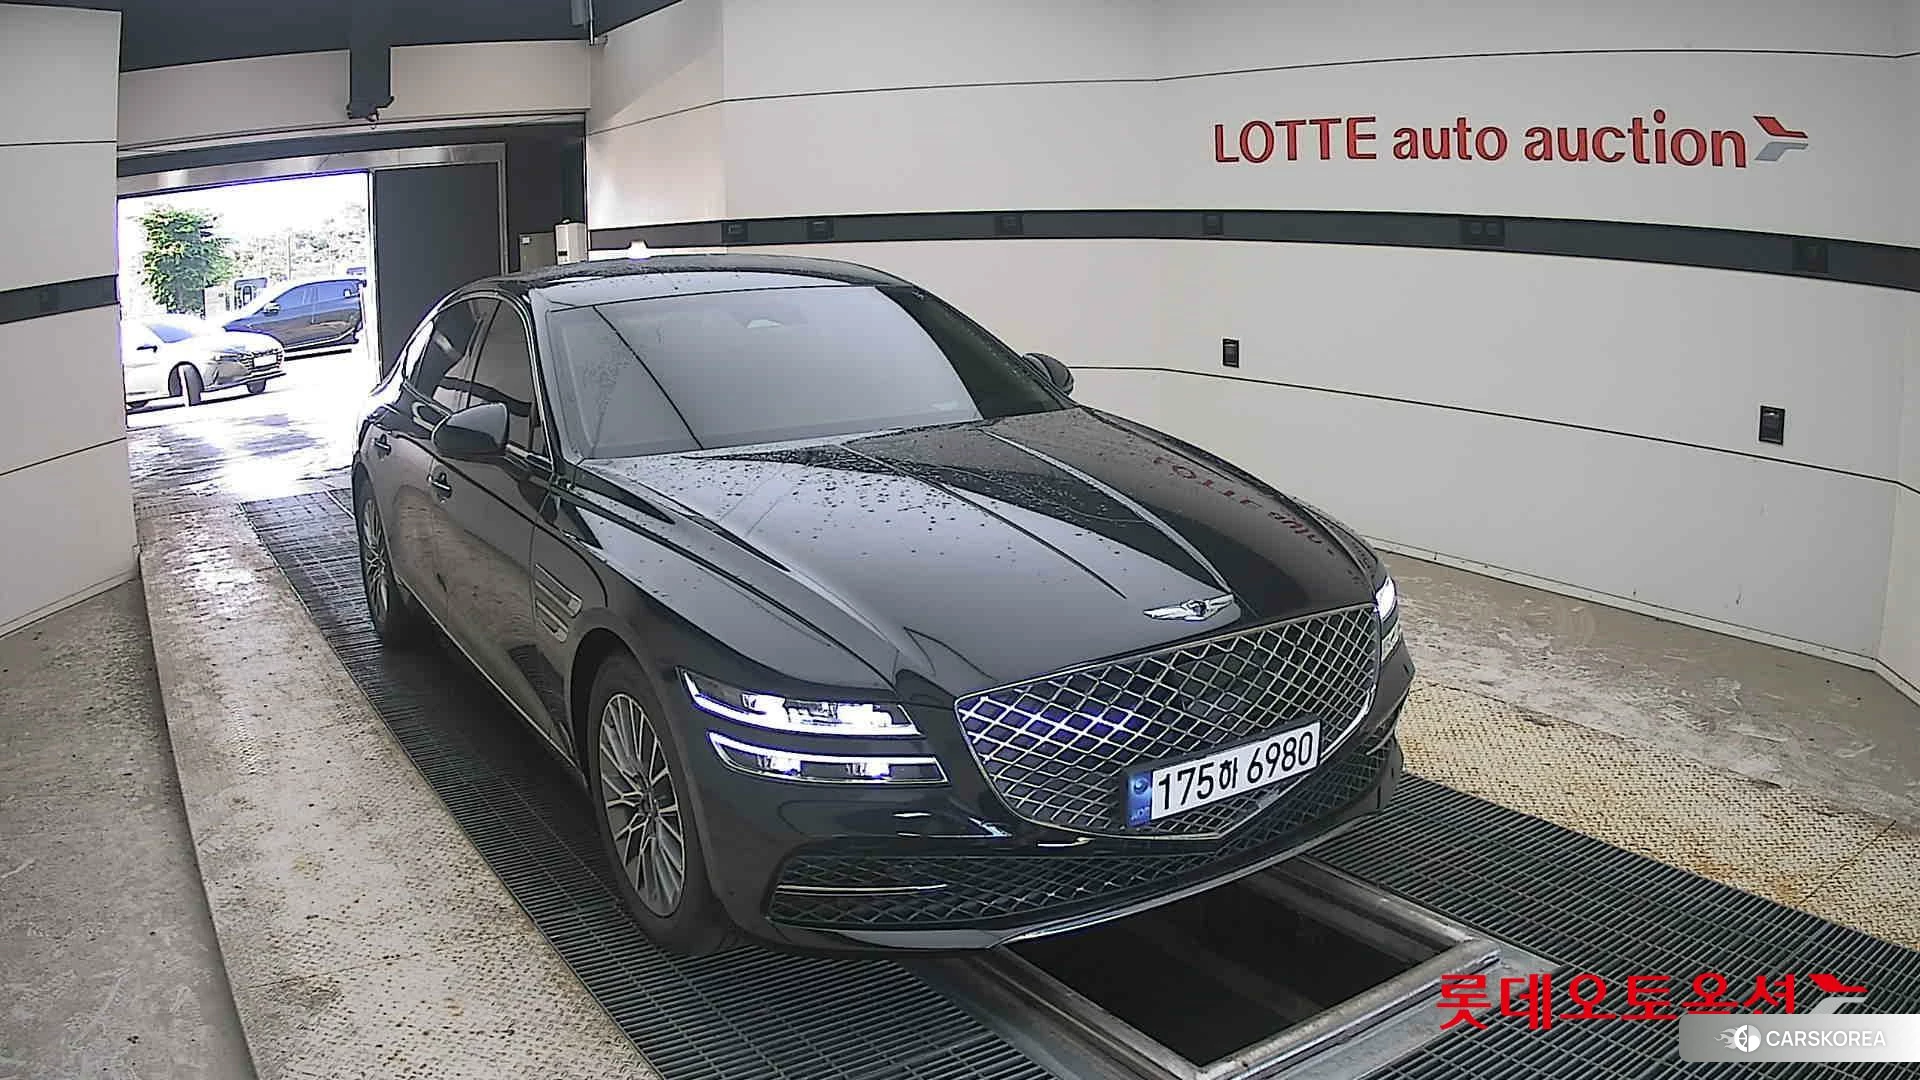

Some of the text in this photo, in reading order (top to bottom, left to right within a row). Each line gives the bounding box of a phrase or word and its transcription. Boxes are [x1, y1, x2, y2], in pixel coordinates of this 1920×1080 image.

[1214, 109, 1747, 168] LOTTE auto auction
[1158, 731, 1314, 810] 175하 6980
